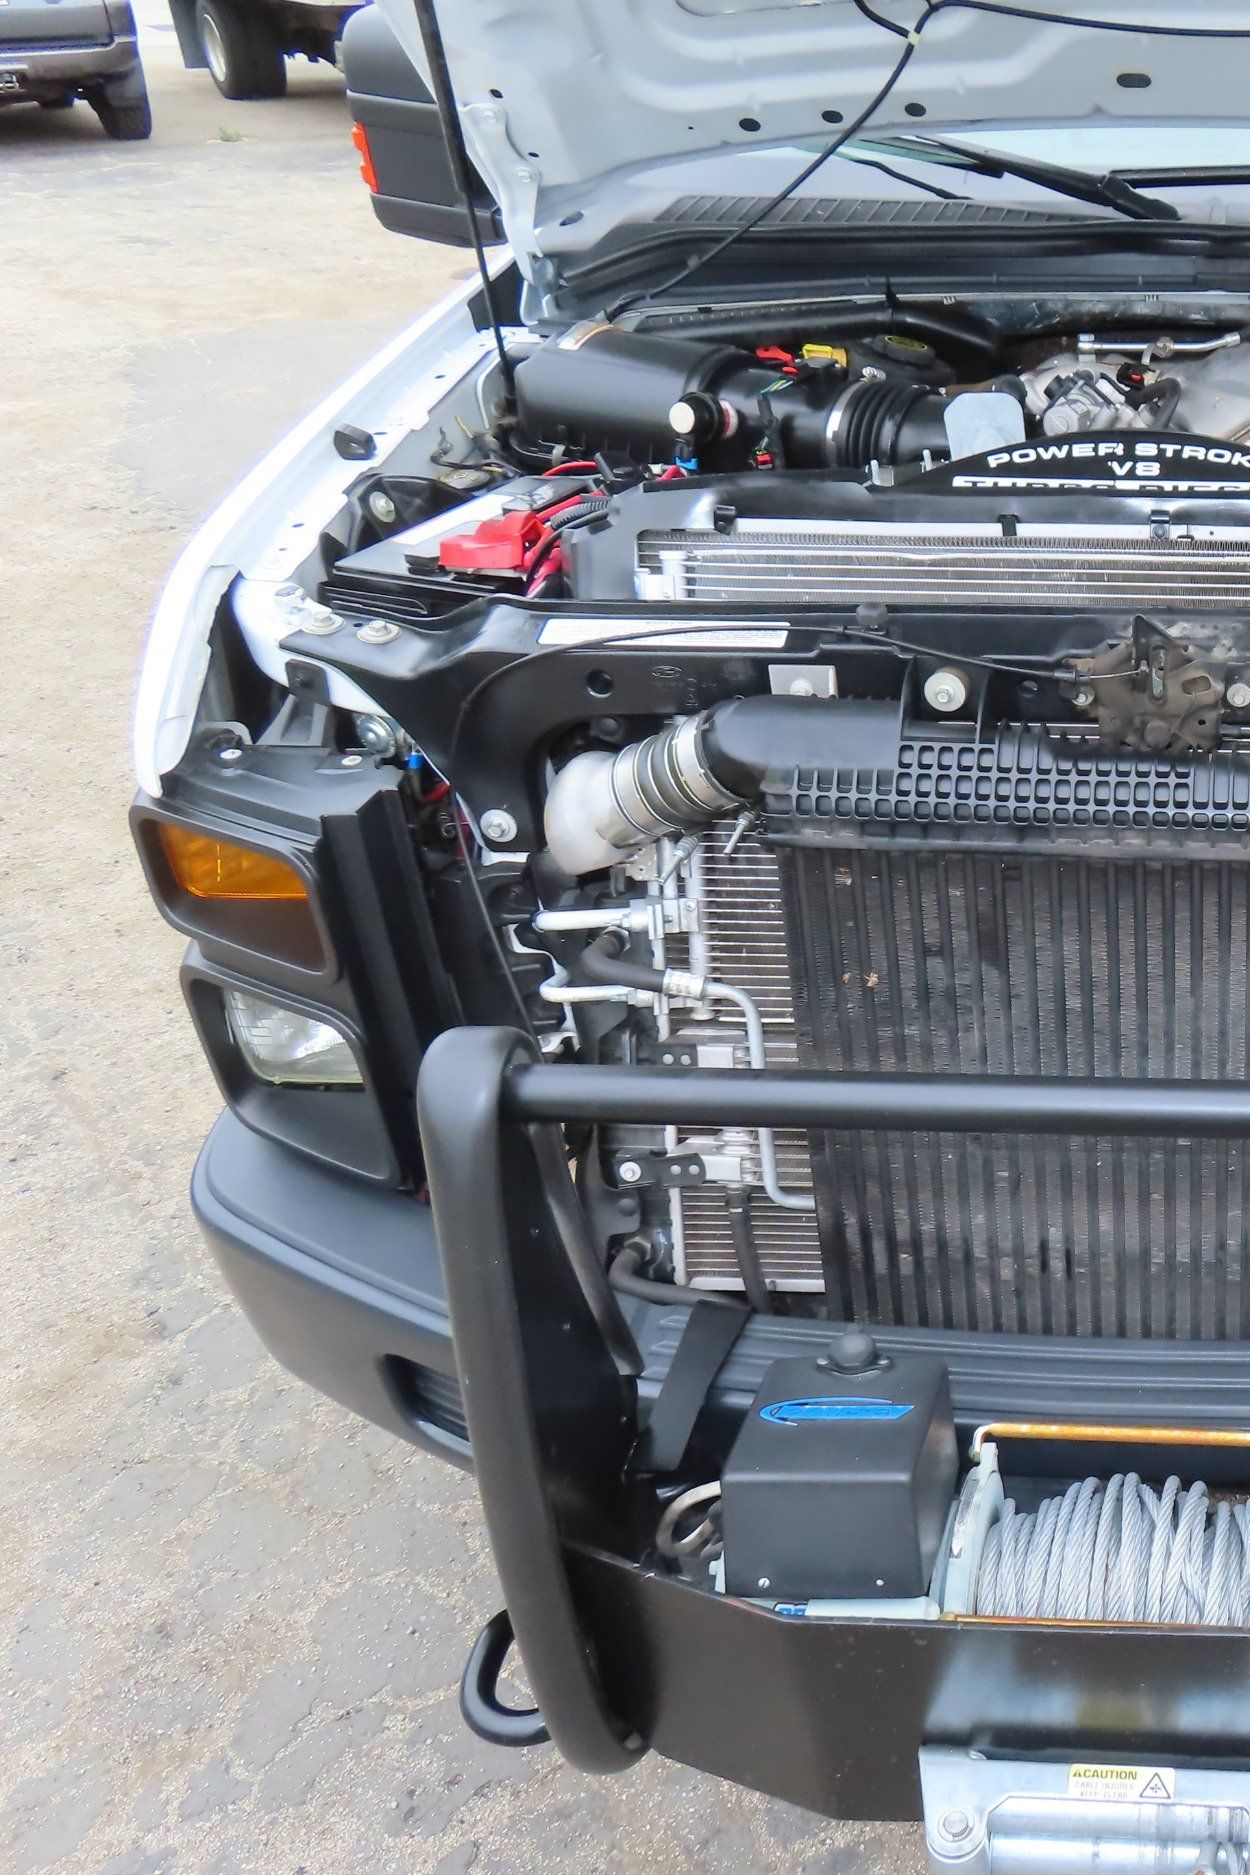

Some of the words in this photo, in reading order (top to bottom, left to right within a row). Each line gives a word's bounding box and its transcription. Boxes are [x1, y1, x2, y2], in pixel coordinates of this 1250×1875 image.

[986, 442, 1124, 469] POWER
[1107, 460, 1161, 477] V8
[1083, 1769, 1138, 1780] CAUTION
